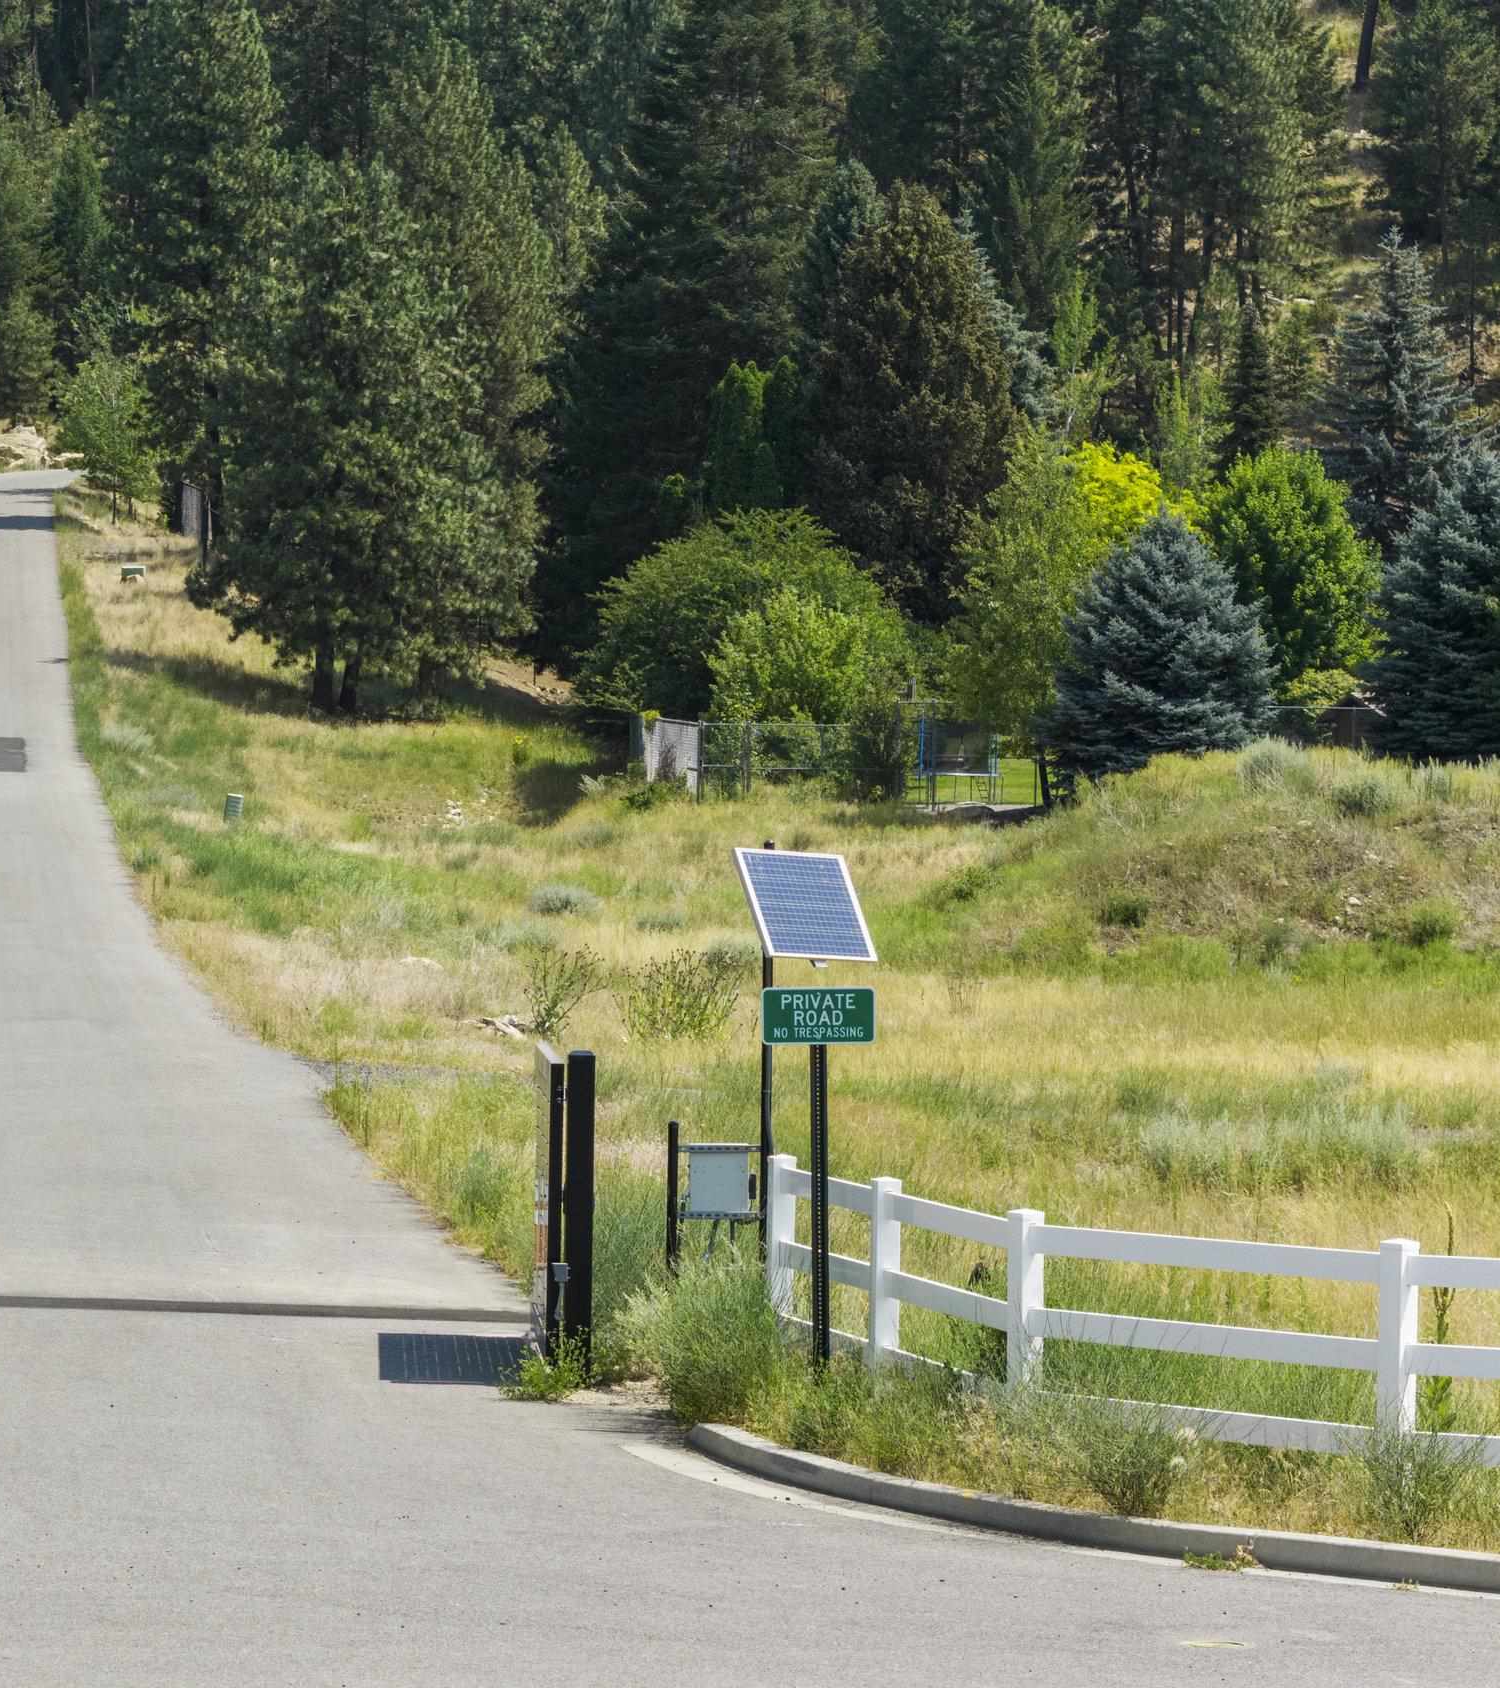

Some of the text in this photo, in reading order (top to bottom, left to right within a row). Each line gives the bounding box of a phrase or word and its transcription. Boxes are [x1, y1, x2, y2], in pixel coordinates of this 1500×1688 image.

[780, 993, 856, 1010] PRIVATE
[793, 1010, 844, 1026] ROAD
[773, 1027, 864, 1038] NO TRESPASSING
